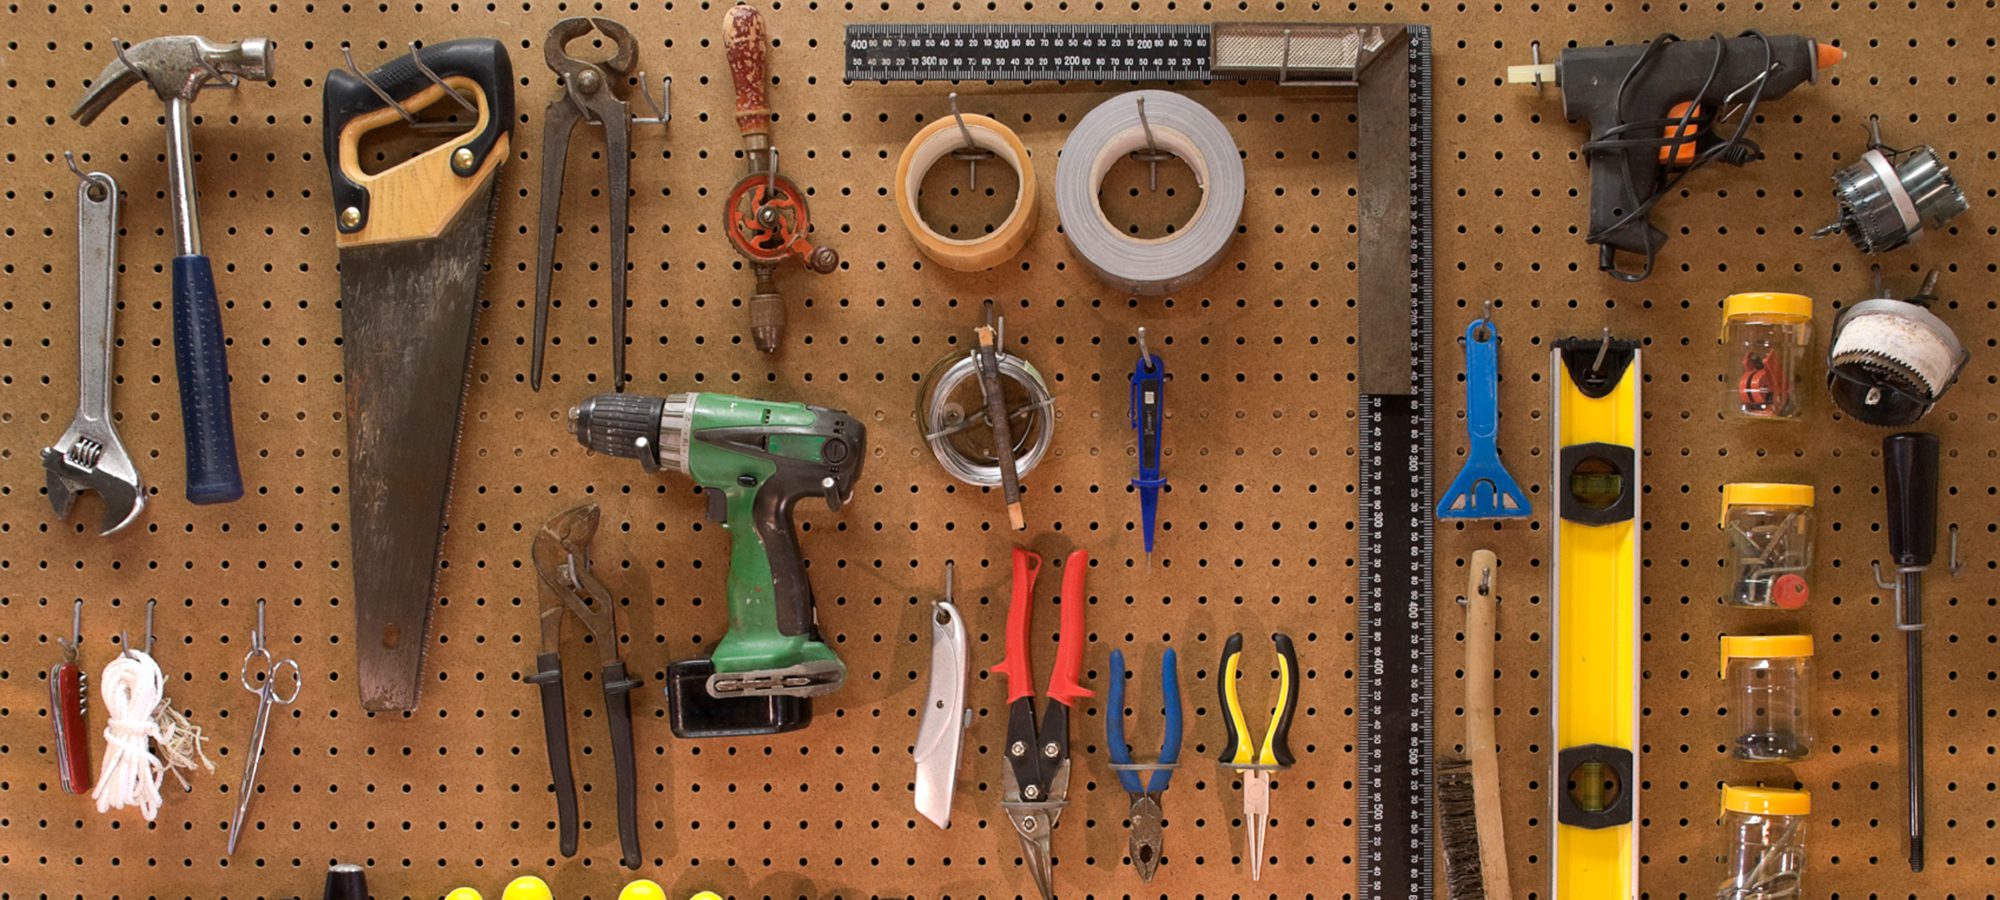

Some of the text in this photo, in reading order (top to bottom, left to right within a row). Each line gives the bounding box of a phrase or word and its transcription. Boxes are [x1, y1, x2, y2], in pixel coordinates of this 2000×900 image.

[850, 38, 1207, 50] 400 90 80 70 60 50 40 30 20 10 300 90 80 70 60 50 40 30 20 10 200 90 80 70 60
[852, 57, 863, 66] 50
[867, 57, 878, 66] 40
[880, 57, 892, 66] 30
[895, 57, 906, 66] 20
[910, 57, 920, 66] 10
[920, 55, 938, 67] 300
[938, 57, 949, 66] 90
[952, 57, 963, 66] 80
[981, 57, 992, 66] 60
[995, 57, 1006, 66] 50
[1010, 57, 1020, 66] 40
[1024, 57, 1035, 66] 30
[1038, 57, 1049, 66] 20
[1053, 57, 1063, 66] 10
[1063, 55, 1081, 66] 200
[1081, 57, 1092, 66] 90
[1095, 57, 1106, 66] 80
[1110, 57, 1120, 66] 70
[1124, 57, 1134, 66] 60
[1138, 57, 1149, 66] 50
[1152, 57, 1164, 66] 40
[1167, 57, 1177, 66] 30
[1181, 57, 1192, 66] 20
[1196, 57, 1206, 66] 10
[1373, 397, 1382, 408] 20
[1410, 400, 1419, 410] 60
[1373, 412, 1382, 422] 30
[1410, 415, 1419, 425] 70
[1373, 426, 1382, 437] 40
[1410, 429, 1419, 439] 80
[1373, 441, 1382, 452] 50
[1410, 443, 1419, 454] 90
[1373, 455, 1382, 466] 60
[1408, 455, 1419, 472] 300
[1373, 471, 1382, 481] 70
[1411, 474, 1419, 483] 10
[1373, 485, 1382, 496] 80
[1410, 488, 1419, 498] 20
[1373, 499, 1382, 510] 90
[1410, 502, 1419, 513] 30
[1373, 511, 1384, 528] 300
[1410, 517, 1419, 528] 40
[1374, 531, 1382, 540] 10
[1410, 531, 1419, 542] 50
[1373, 543, 1382, 554] 20
[1410, 545, 1419, 557] 60
[1373, 558, 1382, 568] 30
[1410, 561, 1419, 571] 70
[1373, 572, 1382, 583] 40
[1410, 575, 1419, 586] 80
[1373, 587, 1382, 598] 50
[1410, 590, 1419, 601] 90
[1373, 602, 1382, 613] 60
[1408, 601, 1419, 619] 400
[1373, 617, 1382, 627] 70
[1411, 620, 1419, 630] 10
[1373, 631, 1382, 642] 80
[1410, 634, 1419, 645] 20
[1373, 646, 1382, 657] 90
[1410, 648, 1419, 659] 30
[1373, 657, 1384, 675] 400
[1410, 663, 1419, 674] 40
[1373, 677, 1382, 687] 10
[1410, 678, 1419, 689] 50
[1373, 690, 1382, 701] 20
[1410, 692, 1419, 704] 60
[1373, 705, 1382, 715] 30
[1410, 708, 1419, 718] 70
[1373, 719, 1382, 730] 40
[1410, 722, 1419, 733] 80
[1373, 734, 1382, 745] 50
[1410, 736, 1419, 747] 90
[1373, 748, 1382, 759] 60
[1408, 748, 1419, 765] 500
[1373, 764, 1382, 774] 70
[1411, 767, 1419, 776] 10
[1373, 777, 1382, 788] 80
[1410, 780, 1419, 791] 20
[1373, 792, 1382, 802] 90
[1410, 795, 1419, 805] 30
[1373, 803, 1384, 821] 500
[1410, 809, 1419, 820] 40
[1373, 823, 1382, 833] 10
[1410, 823, 1419, 835] 50
[1373, 836, 1382, 847] 20
[1410, 838, 1419, 849] 60
[1373, 851, 1382, 862] 30
[1410, 854, 1419, 864] 70
[1373, 865, 1382, 877] 40
[1410, 868, 1419, 879] 80
[1373, 880, 1382, 891] 50
[1410, 882, 1418, 893] 90
